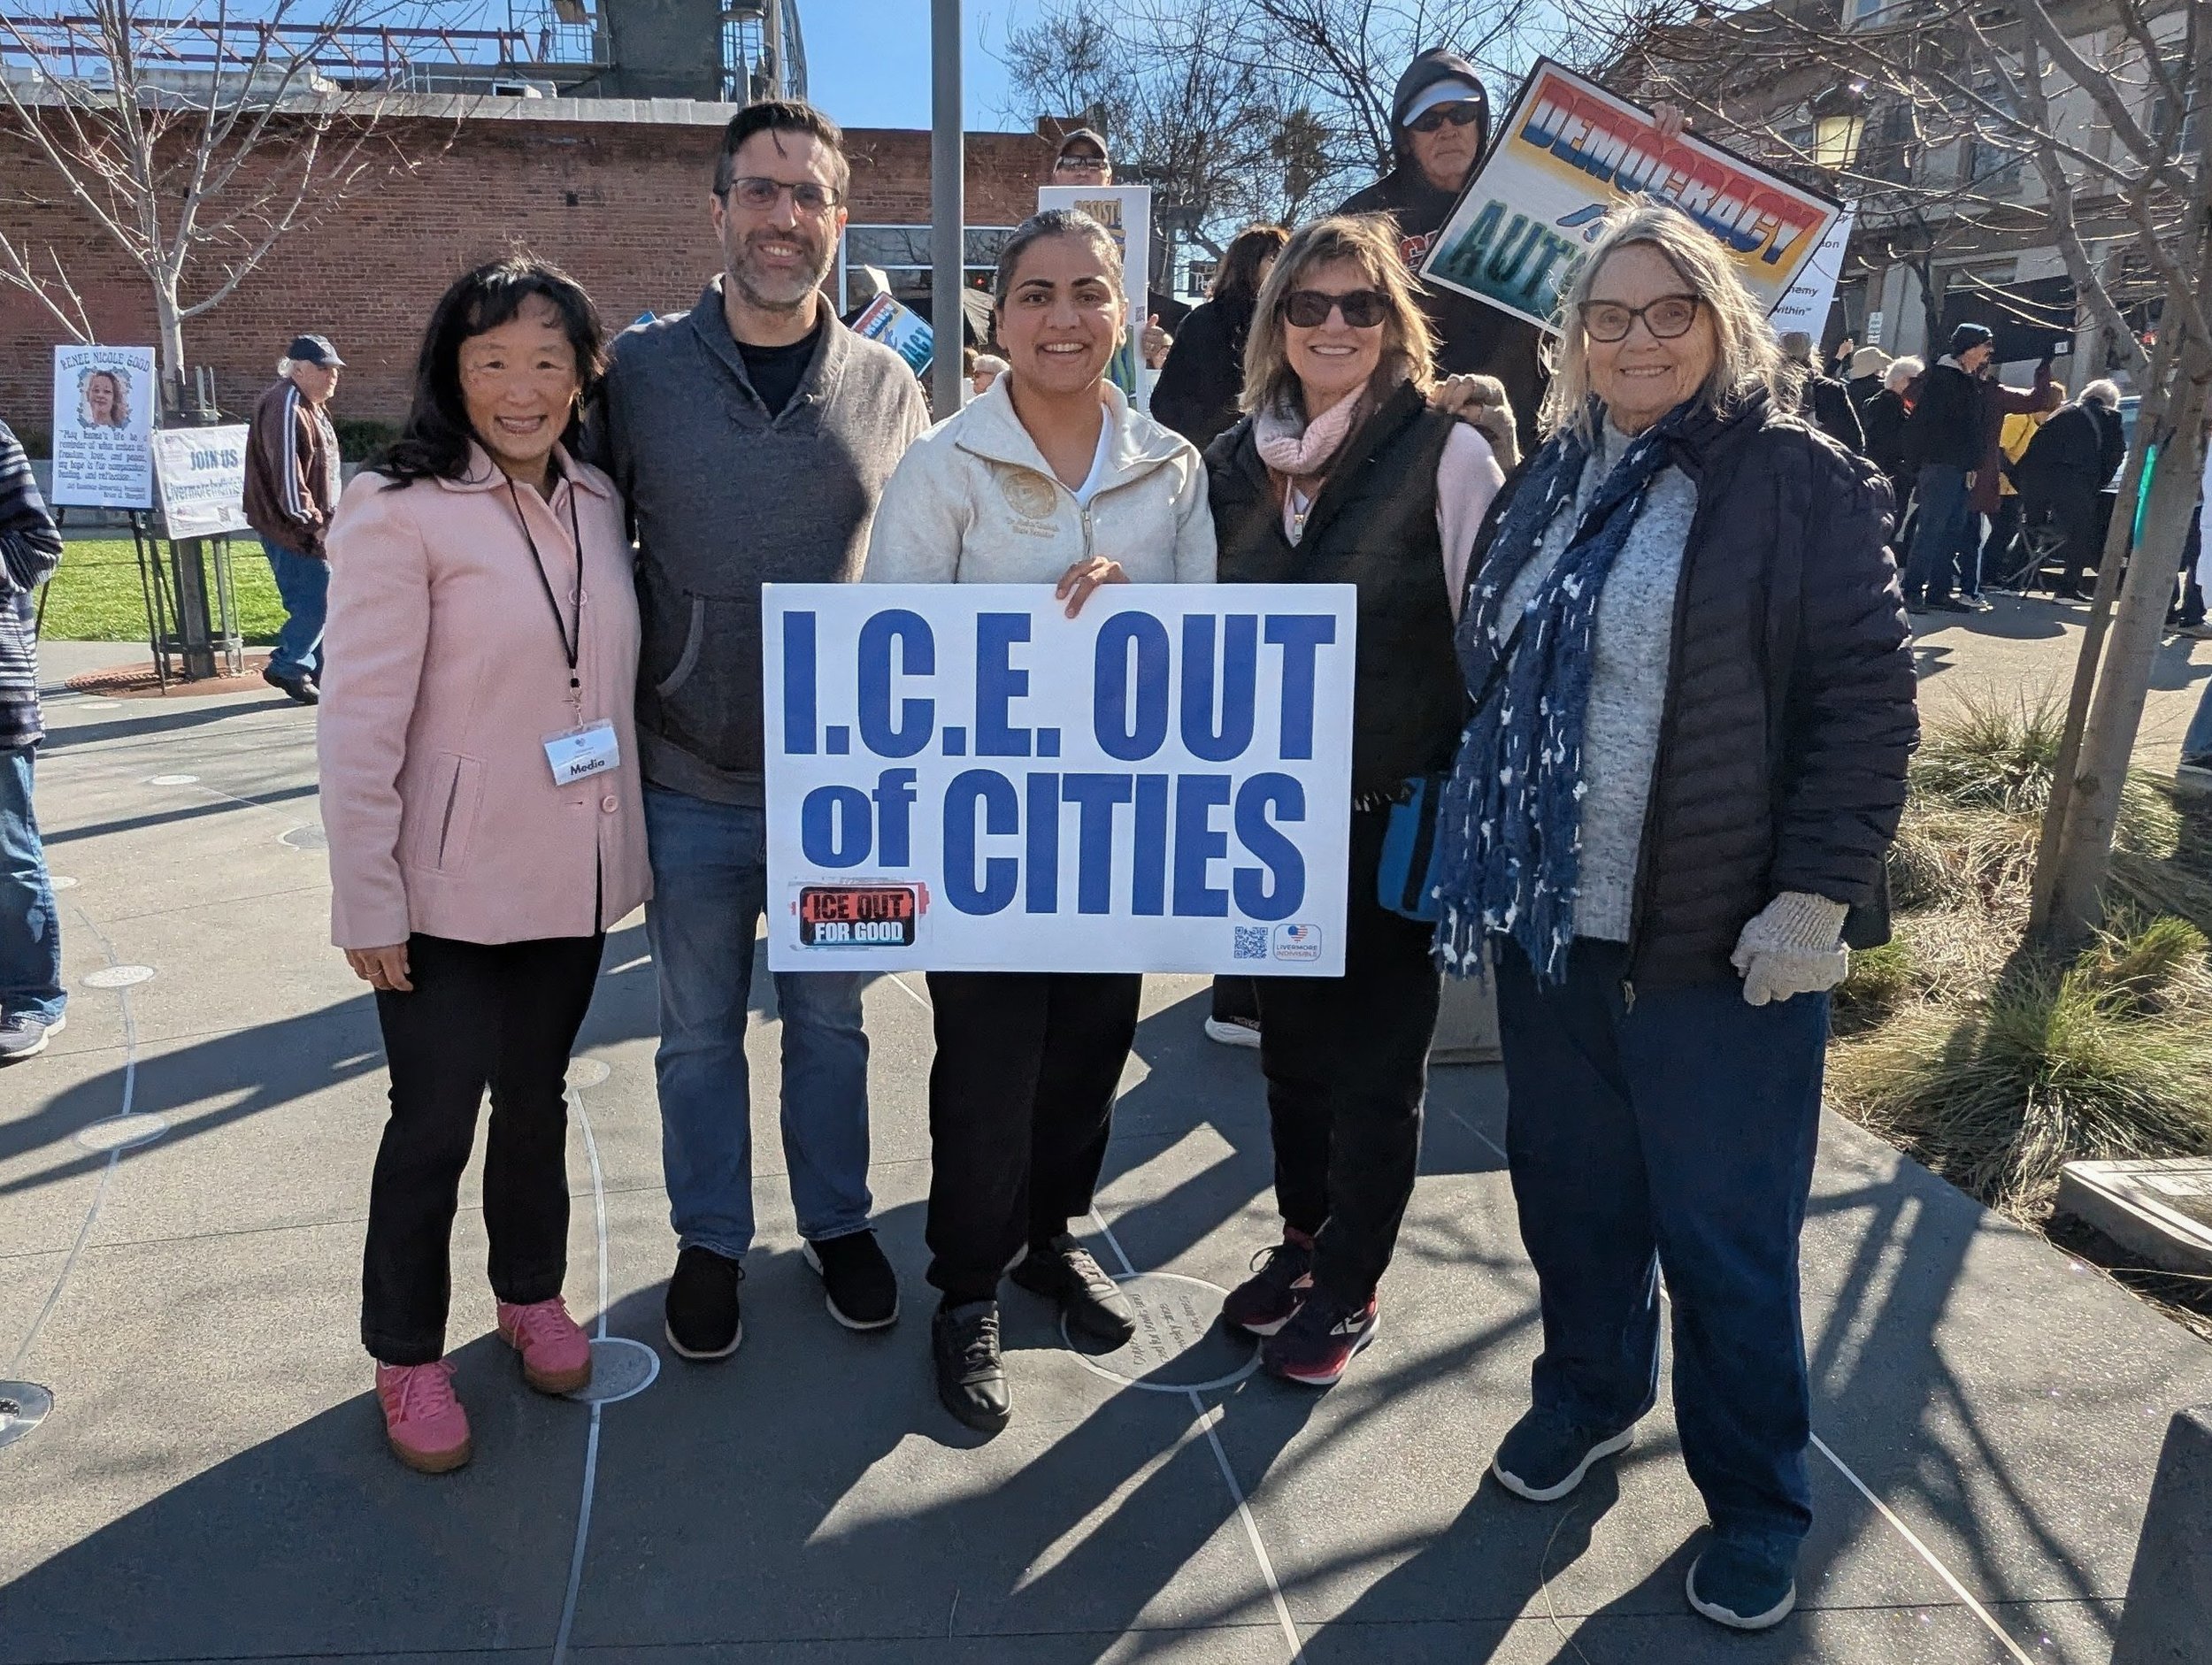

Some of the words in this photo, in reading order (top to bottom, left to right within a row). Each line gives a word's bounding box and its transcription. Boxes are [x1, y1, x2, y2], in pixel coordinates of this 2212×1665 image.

[1519, 83, 1821, 265] DEMOCRACY
[59, 352, 90, 371] RENEE
[93, 351, 124, 364] NICOLE
[127, 355, 150, 372] GOOD
[190, 450, 218, 471] JOIN
[220, 449, 238, 469] US
[783, 609, 1061, 758] I.C.E.
[1094, 610, 1336, 762] OUT
[801, 768, 918, 869] of
[942, 769, 1306, 921] CITIES
[813, 894, 850, 920] ICE
[856, 894, 903, 920] OUT
[814, 921, 850, 942] FOR
[854, 921, 903, 942] GOOD
